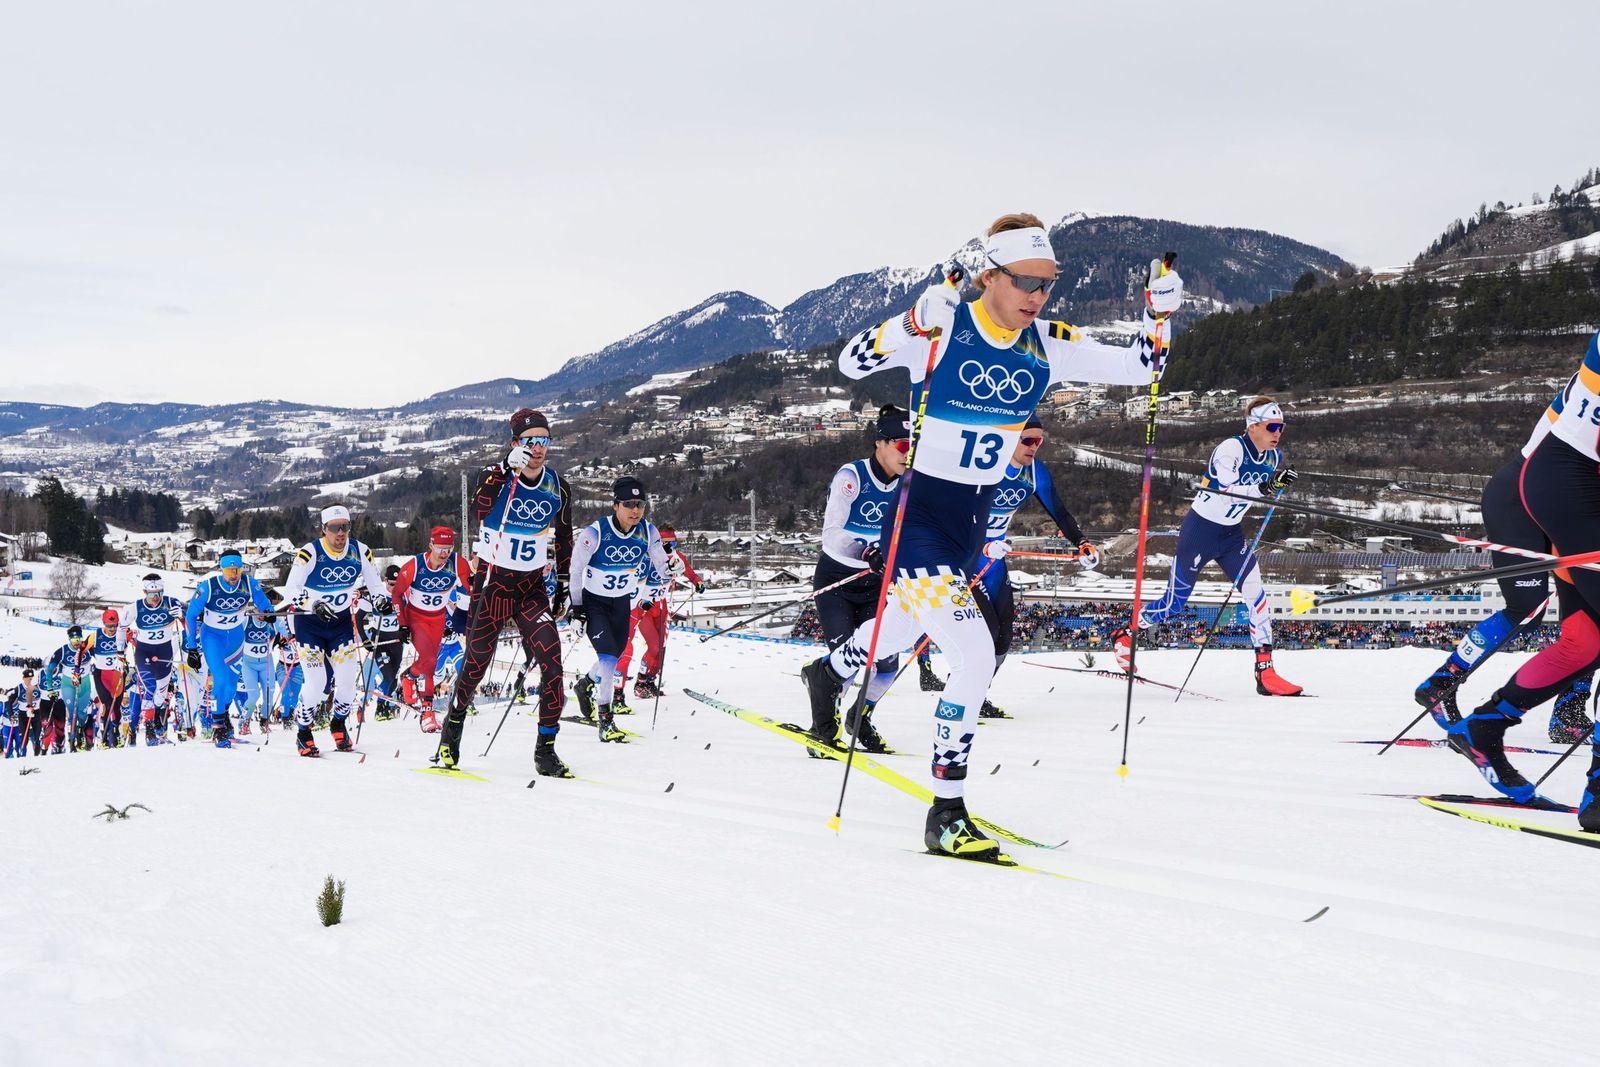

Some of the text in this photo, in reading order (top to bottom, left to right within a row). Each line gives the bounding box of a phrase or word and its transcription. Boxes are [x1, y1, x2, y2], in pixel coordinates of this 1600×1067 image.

[914, 390, 930, 434] LEKI
[946, 399, 983, 412] MILANO
[983, 406, 1016, 416] CORTINA
[959, 429, 1004, 470] 13
[1225, 503, 1248, 519] 17
[510, 538, 536, 562] 15
[603, 574, 630, 590] 35
[321, 592, 349, 607] 20
[421, 594, 443, 606] 36
[217, 615, 239, 625] 24
[953, 606, 983, 621] SWE
[382, 618, 398, 628] 34
[147, 630, 165, 640] 23
[250, 645, 268, 655] 40
[1461, 641, 1474, 656] 18
[937, 722, 951, 740] 13
